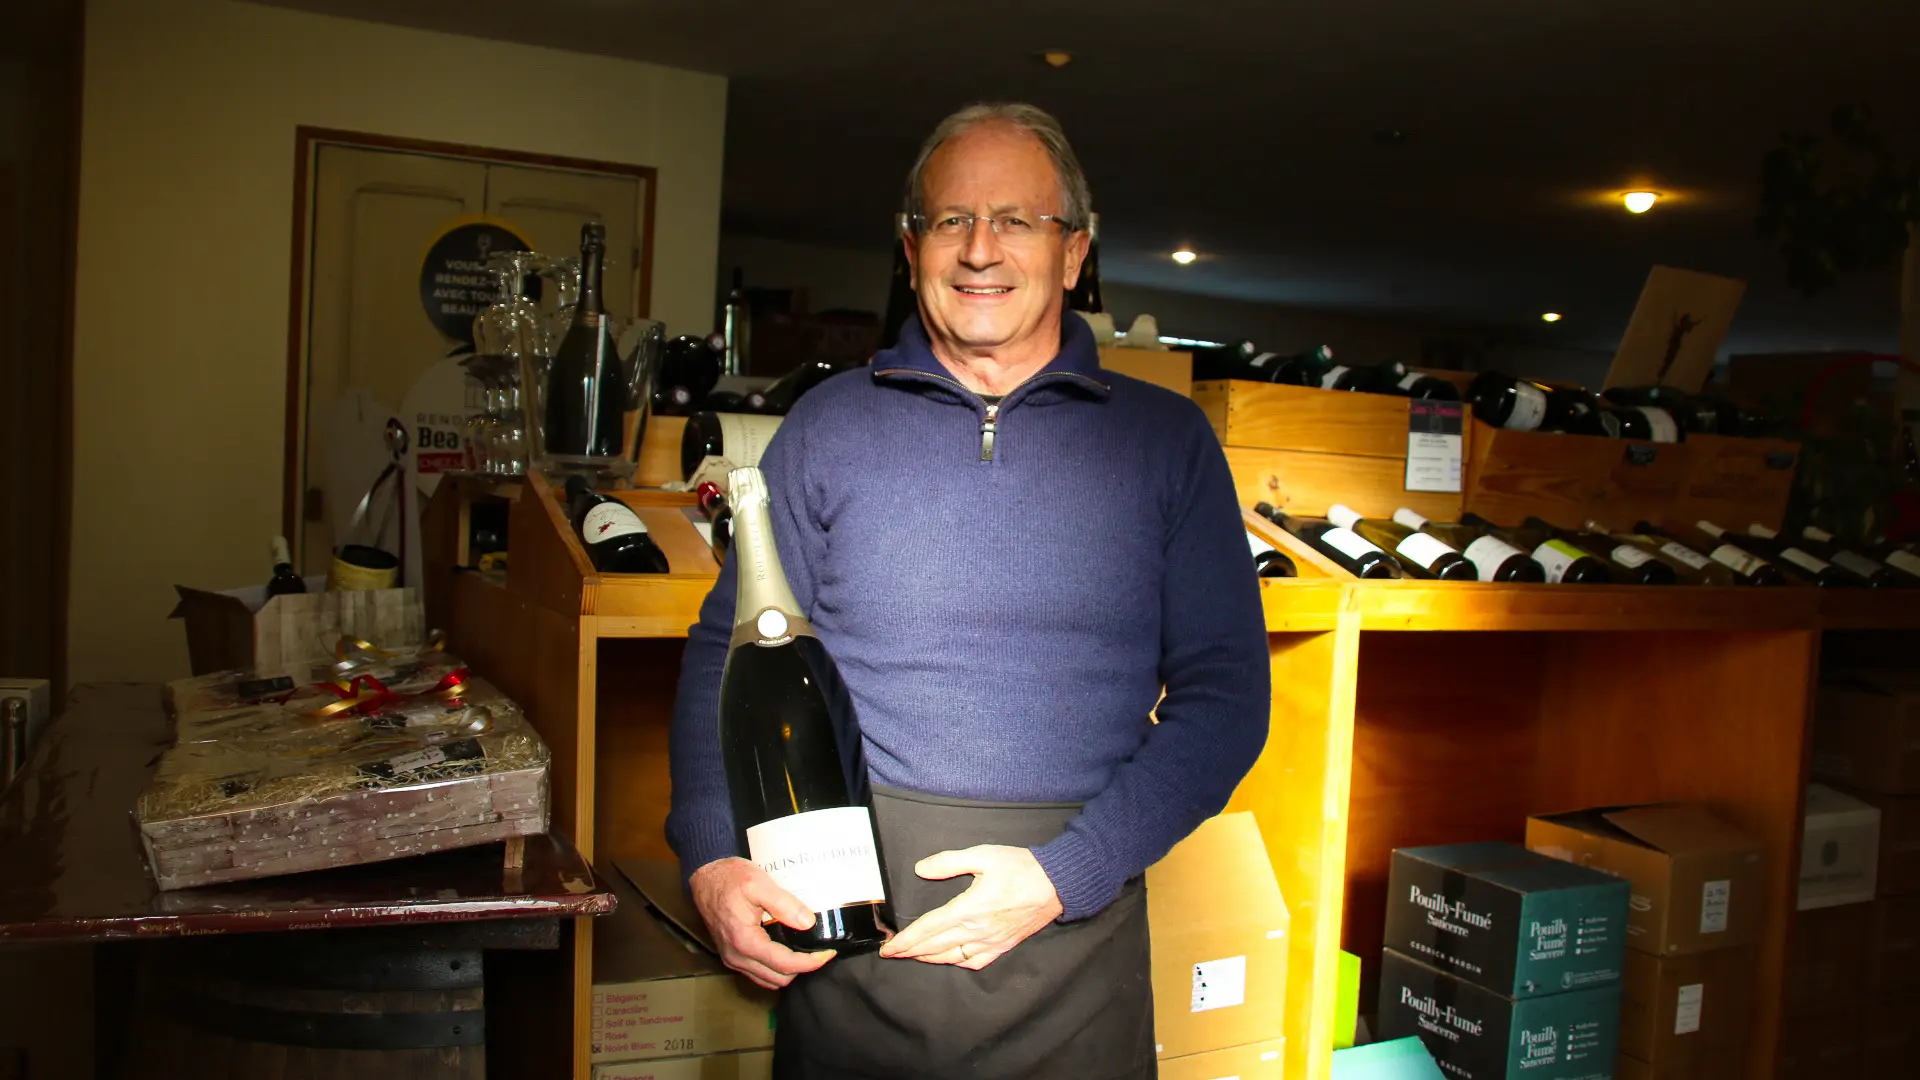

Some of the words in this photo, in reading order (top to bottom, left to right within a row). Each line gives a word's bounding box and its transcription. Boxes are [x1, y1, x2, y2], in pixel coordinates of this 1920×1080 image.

[433, 288, 467, 301] AVEC
[417, 427, 460, 449] Bea
[757, 858, 795, 873] OUIS
[1409, 884, 1493, 930] Pouilly-Fumé
[1427, 910, 1470, 937] Sancerre
[1530, 918, 1568, 938] Pouilly
[1537, 934, 1567, 951] Fumé
[639, 1016, 684, 1025] Tendresse
[1401, 985, 1483, 1036] Pouilly-Fumé
[1418, 1014, 1460, 1042] Sancerre
[1521, 1026, 1557, 1046] Pouilly
[665, 1039, 694, 1051] 2018
[1527, 1041, 1557, 1059] Fumé
